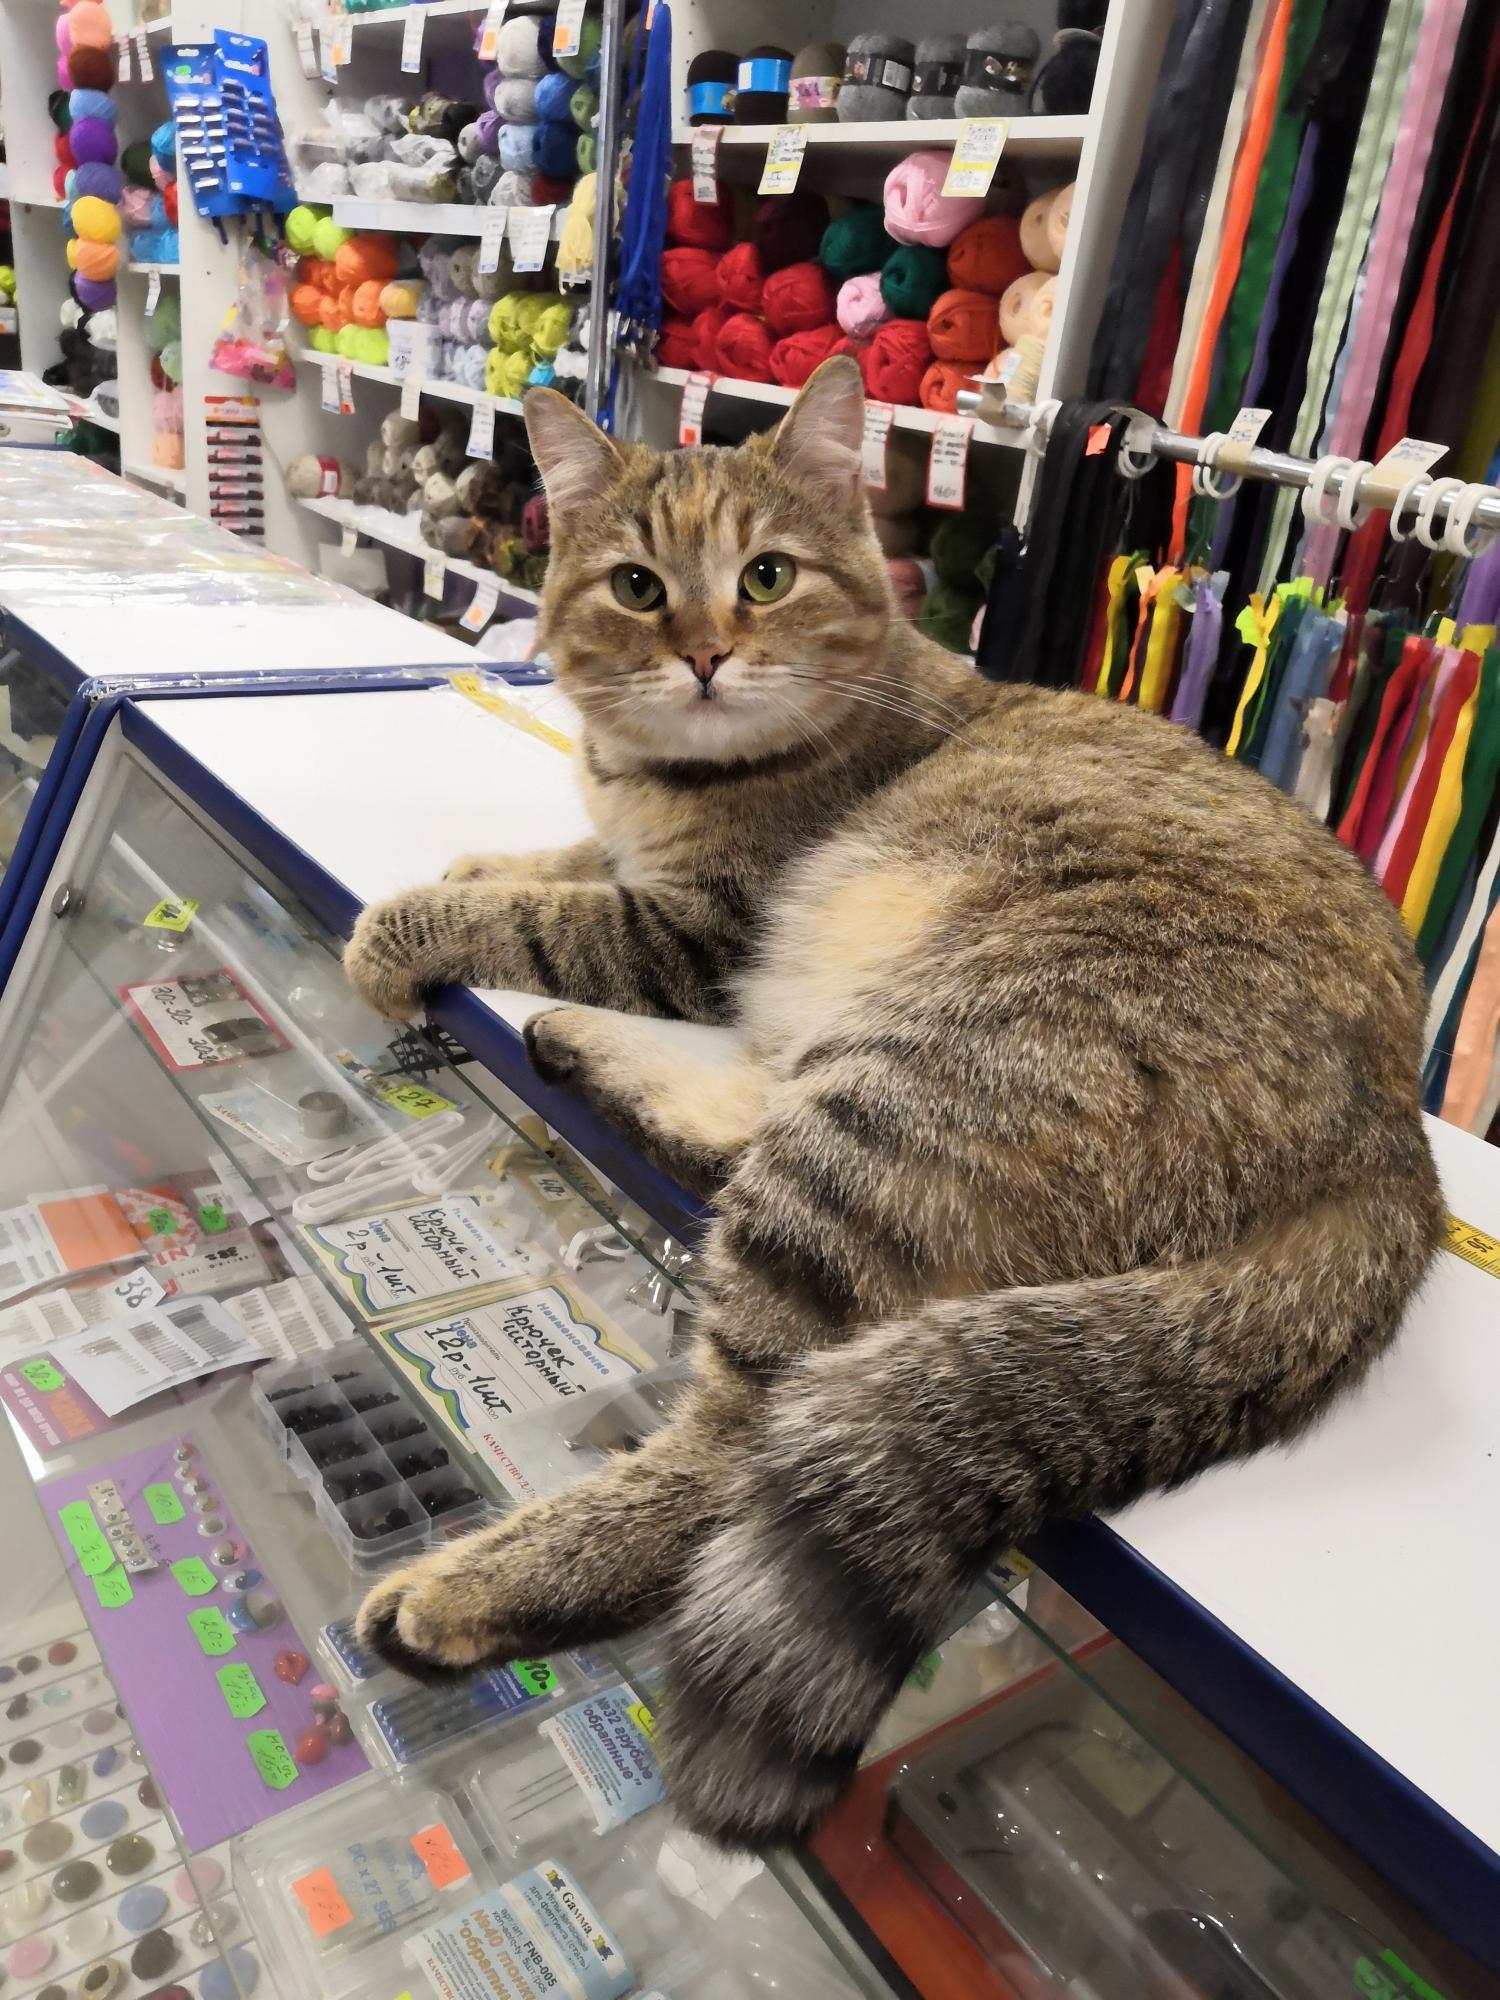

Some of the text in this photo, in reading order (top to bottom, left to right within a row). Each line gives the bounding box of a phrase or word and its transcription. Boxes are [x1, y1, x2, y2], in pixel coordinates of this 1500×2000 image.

[396, 1090, 436, 1109] 27
[368, 1219, 392, 1244] Цена
[115, 1276, 153, 1308] 38
[449, 1320, 477, 1349] Цена
[462, 1317, 501, 1361] Производитель
[506, 1304, 575, 1369] Крючек
[536, 1302, 610, 1376] Наименование
[503, 1319, 587, 1397] шторный
[597, 1696, 622, 1725] №32
[614, 1726, 653, 1780] грубые
[469, 1908, 505, 1949] №40
[523, 1940, 558, 1988] FNB-005
